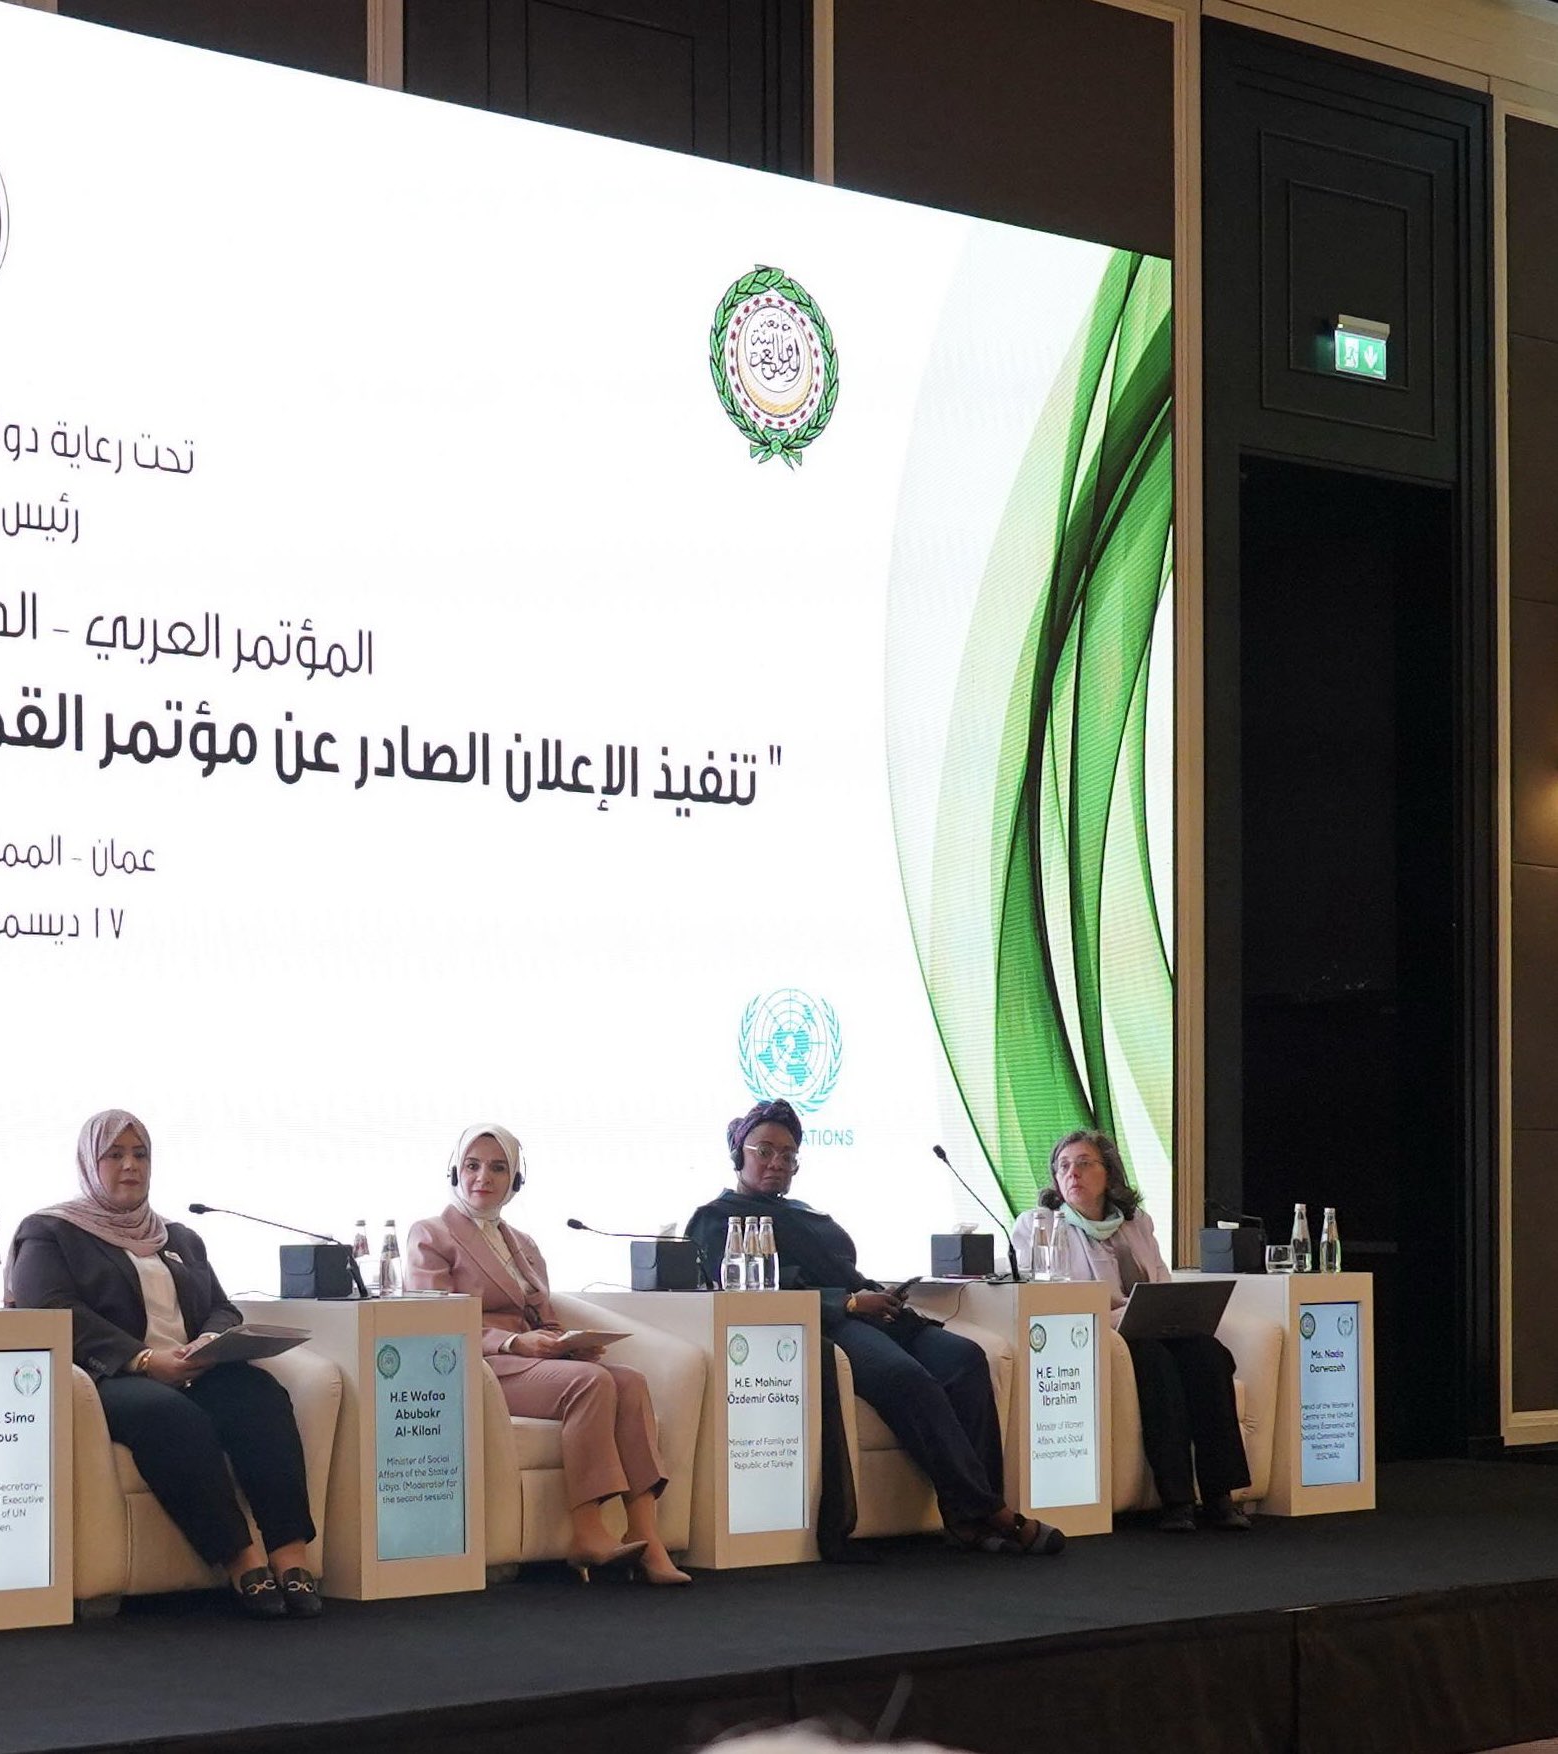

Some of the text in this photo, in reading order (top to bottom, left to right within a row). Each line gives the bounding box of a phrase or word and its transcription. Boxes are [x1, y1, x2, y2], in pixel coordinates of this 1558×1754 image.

[51, 421, 121, 473] رعاية
[134, 434, 193, 474] تحت
[2, 493, 78, 543] رئيس
[84, 612, 221, 668] العربي
[231, 620, 374, 680] المؤتمر
[99, 699, 257, 777] مؤتمر
[274, 711, 339, 784] عن
[354, 725, 490, 789] الصادر
[505, 733, 637, 811] الإعلان
[92, 838, 156, 876] عمان
[95, 907, 124, 939] ١٧
[801, 1129, 854, 1146] ATIONS
[1036, 1366, 1080, 1379] H.E. Iman
[735, 1377, 792, 1388] H.E. Mahinur
[1039, 1381, 1081, 1393] Sulaiman
[411, 1390, 446, 1402] Wafaa
[727, 1391, 800, 1405] Özdemir Göktaş
[1043, 1394, 1077, 1406] Ibrahim
[4, 1411, 35, 1424] Sima
[395, 1408, 441, 1420] Abubakr
[395, 1424, 441, 1437] Al-Kilani
[427, 1455, 450, 1463] Social
[2, 1495, 44, 1505] Executive
[1, 1509, 10, 1519] of
[12, 1509, 26, 1518] UN
